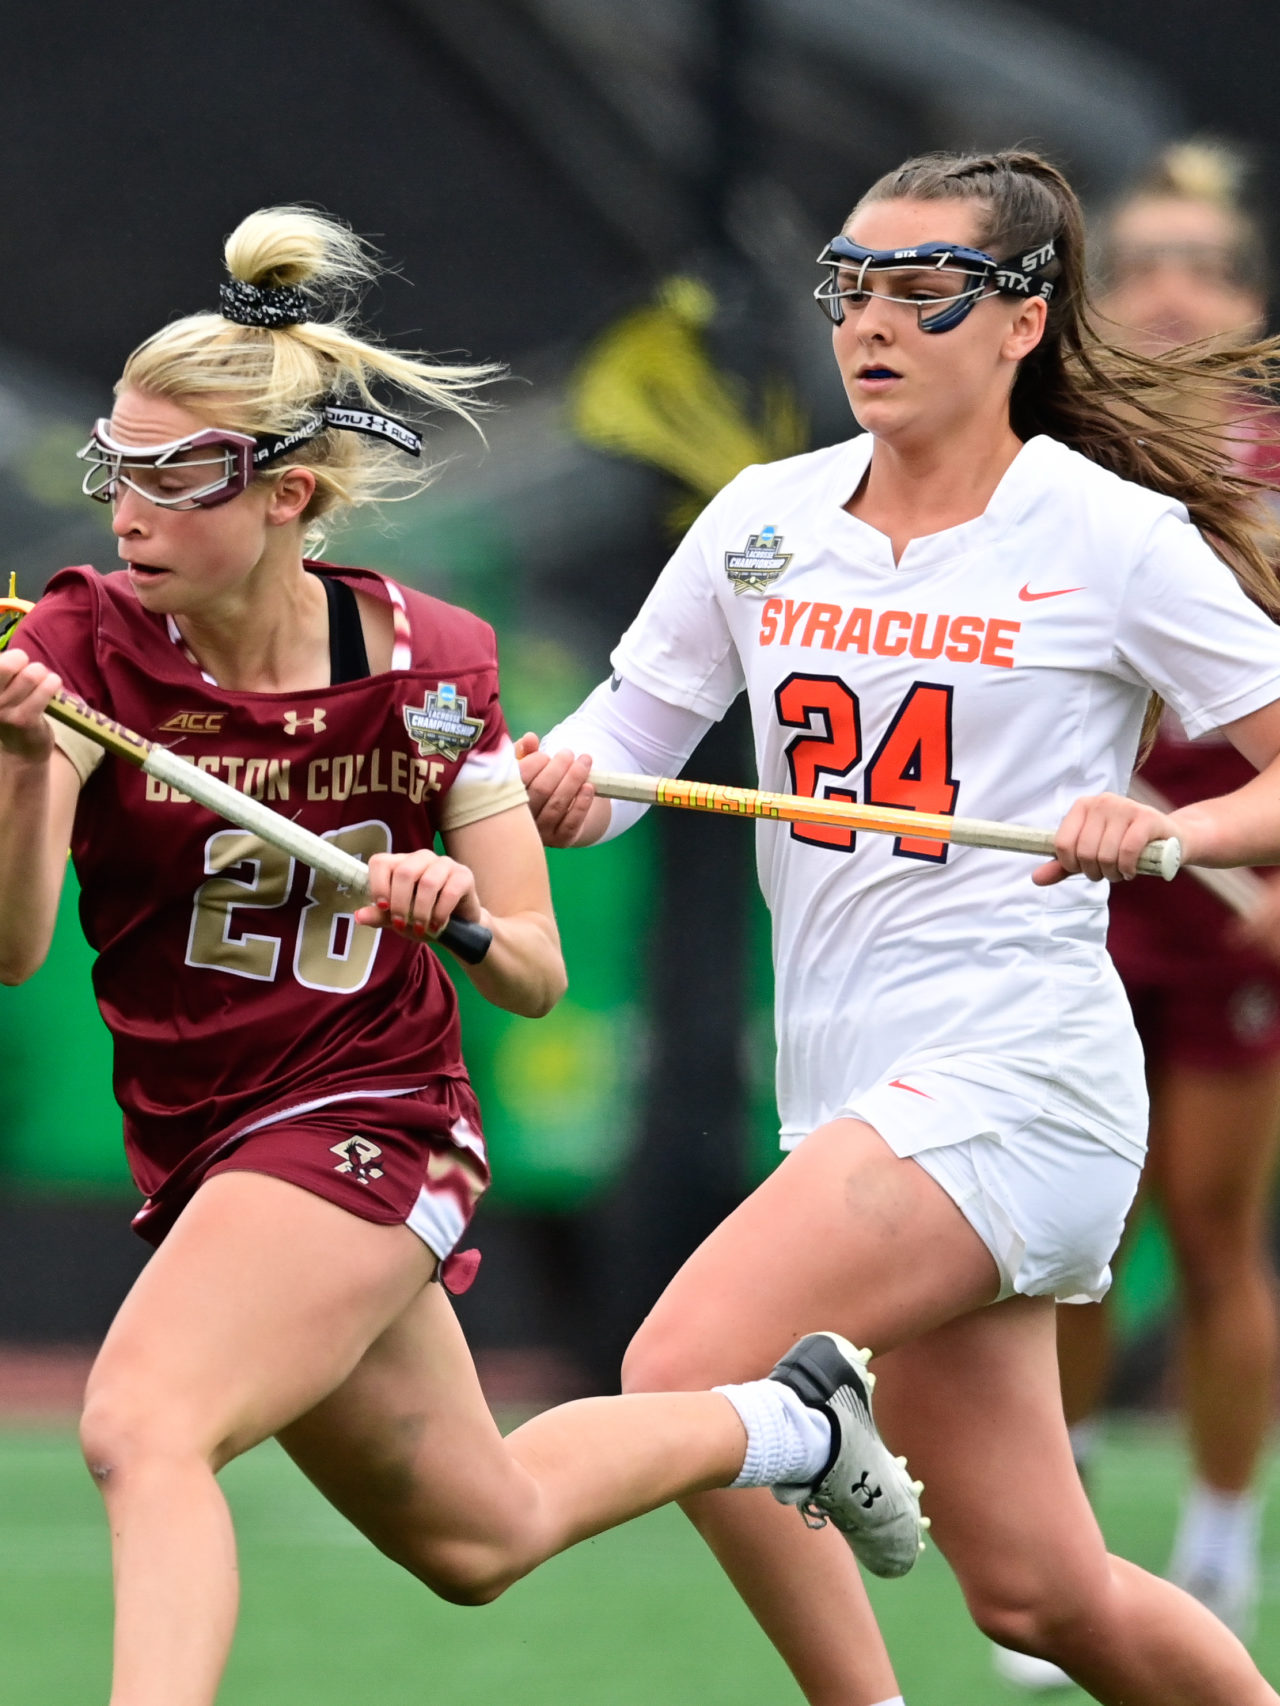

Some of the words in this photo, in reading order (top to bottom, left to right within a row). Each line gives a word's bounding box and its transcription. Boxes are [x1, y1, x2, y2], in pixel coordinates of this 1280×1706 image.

[894, 249, 918, 259] STX
[1022, 239, 1055, 272] STX
[759, 598, 1021, 669] SYRACUSE
[164, 713, 225, 730] ACC
[411, 714, 477, 738] CHAMPIONSHIP
[307, 748, 444, 804] COLLEGE
[774, 671, 961, 865] 24
[184, 819, 393, 994] 28
